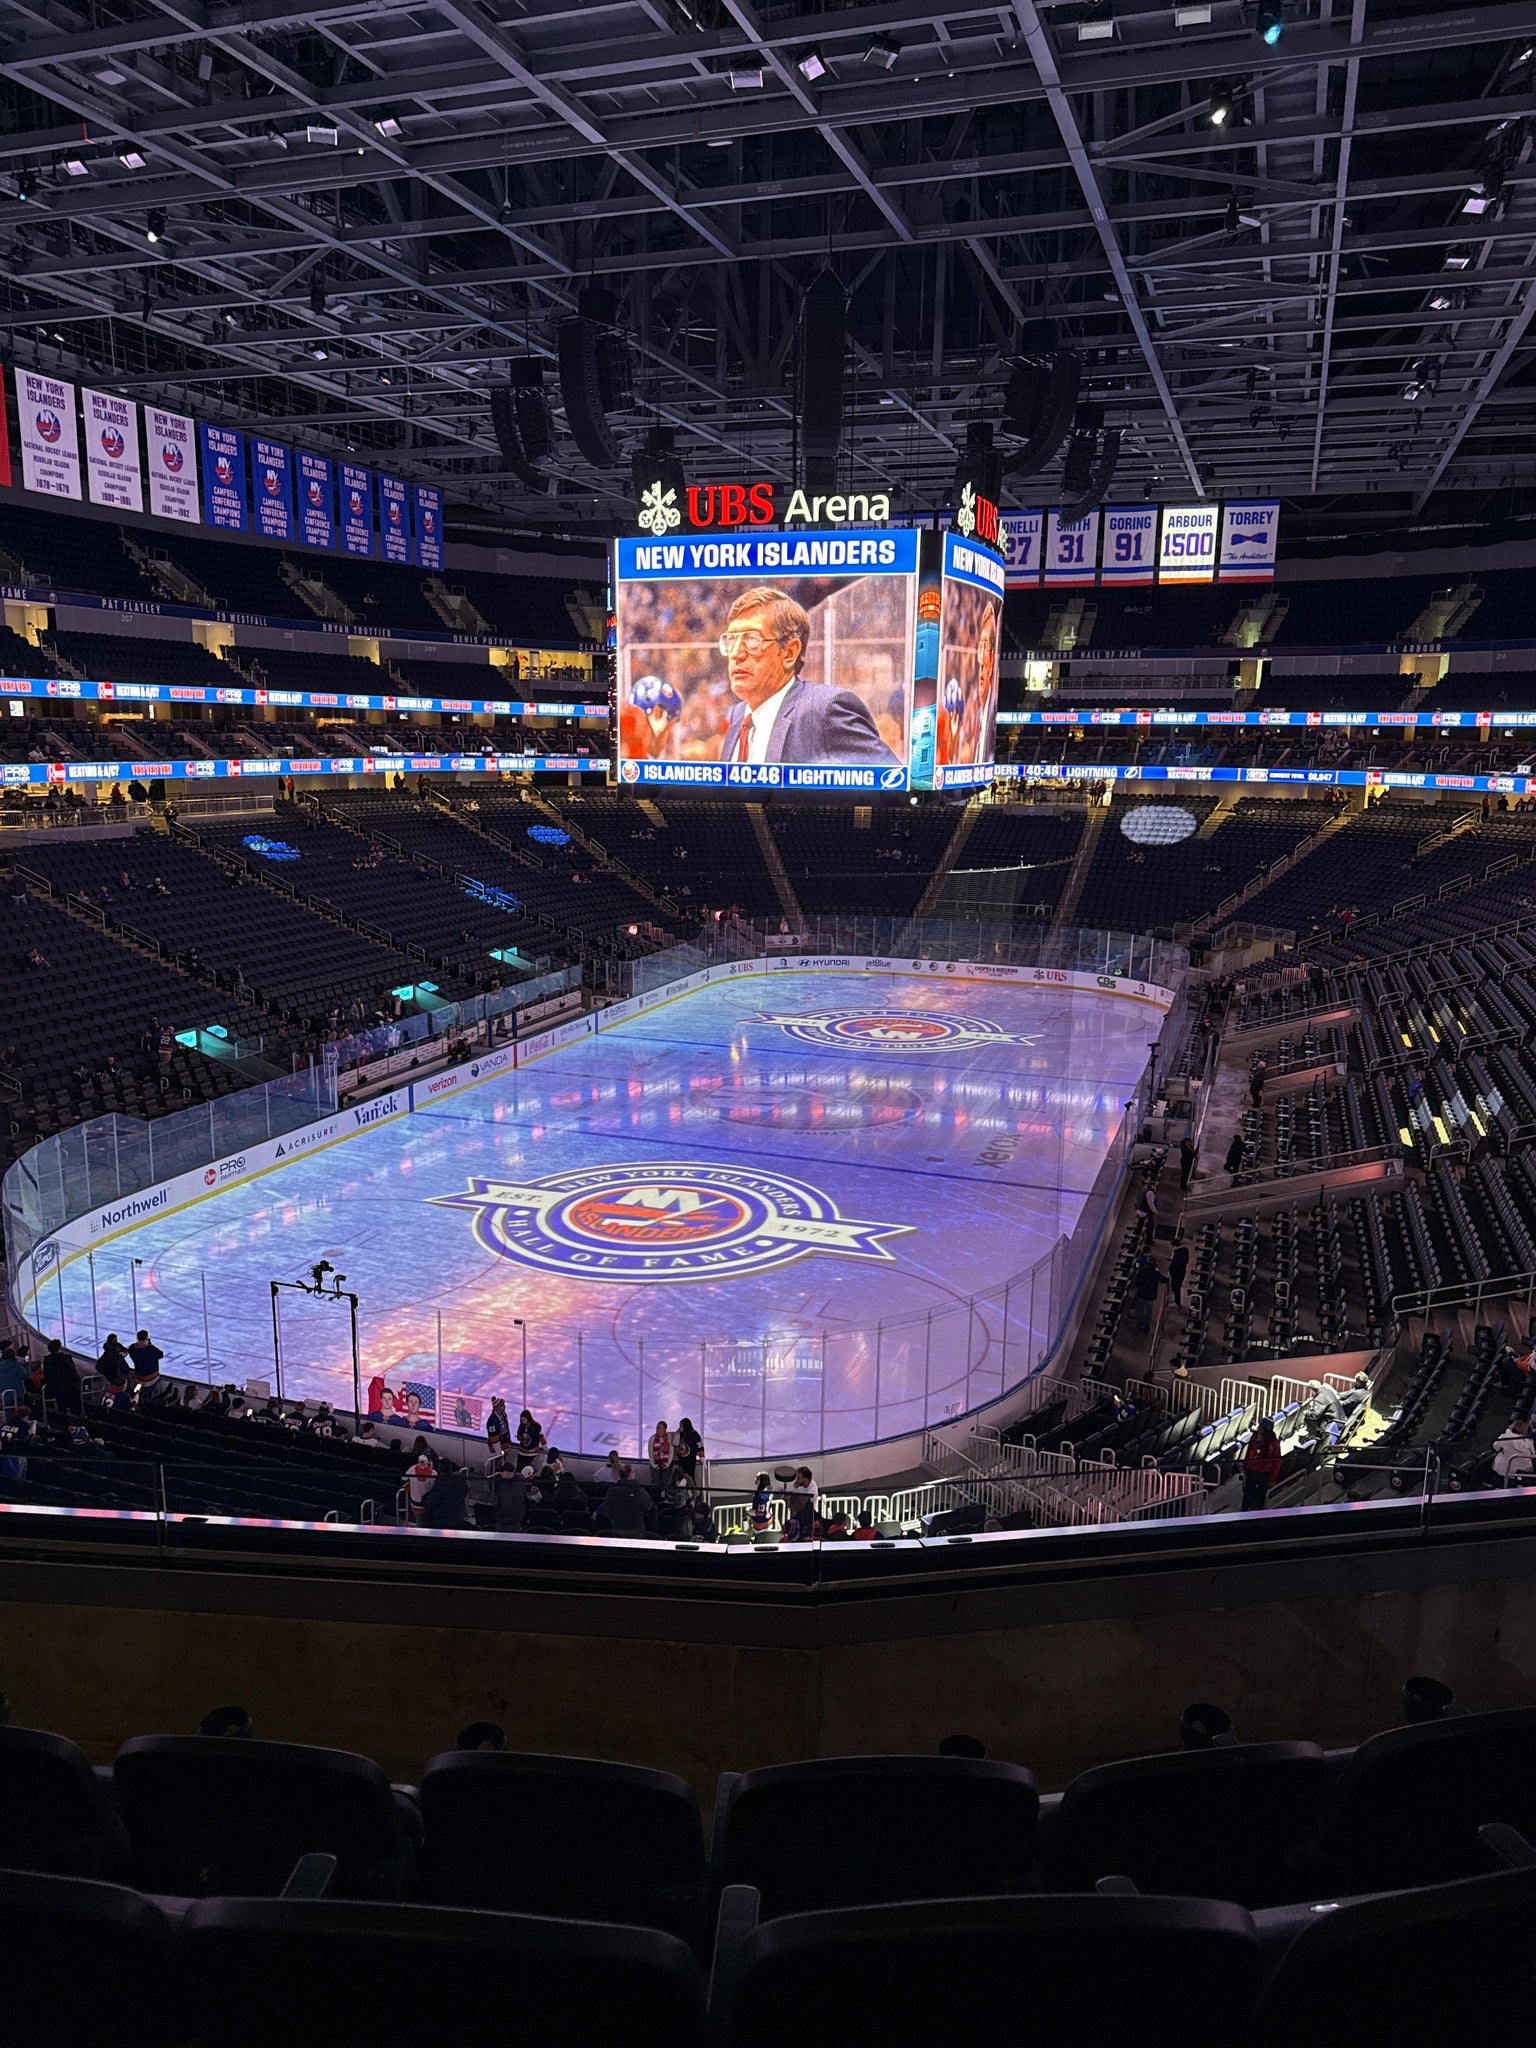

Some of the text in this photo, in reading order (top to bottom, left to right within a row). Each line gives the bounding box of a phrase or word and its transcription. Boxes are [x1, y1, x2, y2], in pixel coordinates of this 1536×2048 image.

[26, 375, 64, 397] NEW YORK
[27, 389, 66, 410] ISLANDERS
[92, 395, 127, 414] NEW YORK
[93, 408, 128, 427] ISLANDERS
[154, 412, 186, 431] NEW YORK
[154, 425, 187, 442] ISLANDERS
[208, 428, 236, 444] NEW YORK
[24, 441, 78, 460] NATIONAL HOCKEY LEAGUE
[208, 440, 237, 456] ISLANDERS
[258, 442, 284, 458] NEW YORK
[54, 459, 70, 470] SEASON
[89, 456, 138, 474] NATIONAL HOCKEY LEAGUE
[258, 454, 284, 469] ISLANDERS
[302, 456, 326, 470] NEW YORK
[40, 468, 64, 480] CHAMPIONS
[152, 471, 168, 480] NATIONAL
[302, 466, 327, 481] ISLANDERS
[344, 467, 366, 480] NEW YORK
[104, 482, 127, 492] CHAMPIONS
[344, 478, 368, 491] ISLANDERS
[384, 478, 404, 492] NEW YORK
[214, 486, 238, 499] CAMPBELL
[384, 488, 404, 502] ISLANDERS
[418, 488, 438, 501] NEW YORK
[212, 496, 240, 509] CONFERENCE
[263, 498, 285, 510] CAMPBELL
[419, 498, 438, 510] ISLANDERS
[686, 483, 890, 526] UBS Arena
[214, 506, 240, 518] CHAMPIONS
[260, 506, 288, 519] CONFERENCE
[306, 508, 327, 520] CAMPBELL
[1230, 511, 1274, 525] TORREY
[262, 516, 286, 528] CHAMPIONS
[305, 517, 330, 530] CONFERENCE
[351, 518, 364, 527] WALES
[976, 496, 998, 543] UBS
[1110, 516, 1152, 530] GORING
[1168, 515, 1212, 528] ARBOUR
[306, 526, 329, 538] CHAMPIONS
[346, 525, 369, 537] CONFERENCE
[347, 534, 368, 545] CHAMPIONS
[1115, 532, 1142, 561] 91
[1163, 532, 1214, 556] 1500
[636, 540, 896, 570] NEW YORK ISLANDERS
[1058, 534, 1084, 563] 31
[953, 545, 974, 573] NEW
[1, 586, 26, 600] FAME
[102, 598, 161, 614] PAT FLATLEY
[121, 615, 132, 623] 207
[216, 612, 267, 626] ED WESTFALL
[322, 624, 392, 638] BRYAN TROTTIER
[453, 634, 513, 646] DENIS POTVIN
[579, 643, 606, 651] CLARK
[1002, 652, 1024, 660] YORK
[1027, 652, 1073, 660] ISLANDERS
[1120, 650, 1142, 659] FAME
[1402, 644, 1442, 653] ARBOUR
[5, 767, 30, 776] PRO
[644, 765, 874, 786] ISLANDERS 40:46 LIGHTNING
[1026, 765, 1058, 776] 40:46
[1066, 768, 1118, 777] LIGHTNING
[1198, 772, 1211, 780] 104
[738, 962, 754, 973] UBS
[866, 960, 891, 968] jetBlue
[1046, 970, 1068, 982] UBS
[480, 1054, 508, 1072] VANDA
[428, 1076, 457, 1094] verizon
[354, 1096, 398, 1126] VanEck
[288, 1126, 334, 1150] ACRISURE
[220, 1156, 246, 1175] PRO
[220, 1168, 246, 1181] PARTNER
[495, 1192, 542, 1202] EST.
[558, 1170, 802, 1216] NEW YORK ISLANDERS
[102, 1189, 167, 1228] Northwell
[577, 1208, 716, 1238] ISLANDERS
[778, 1224, 840, 1238] 1972
[508, 1220, 754, 1268] HALL OF FAME
